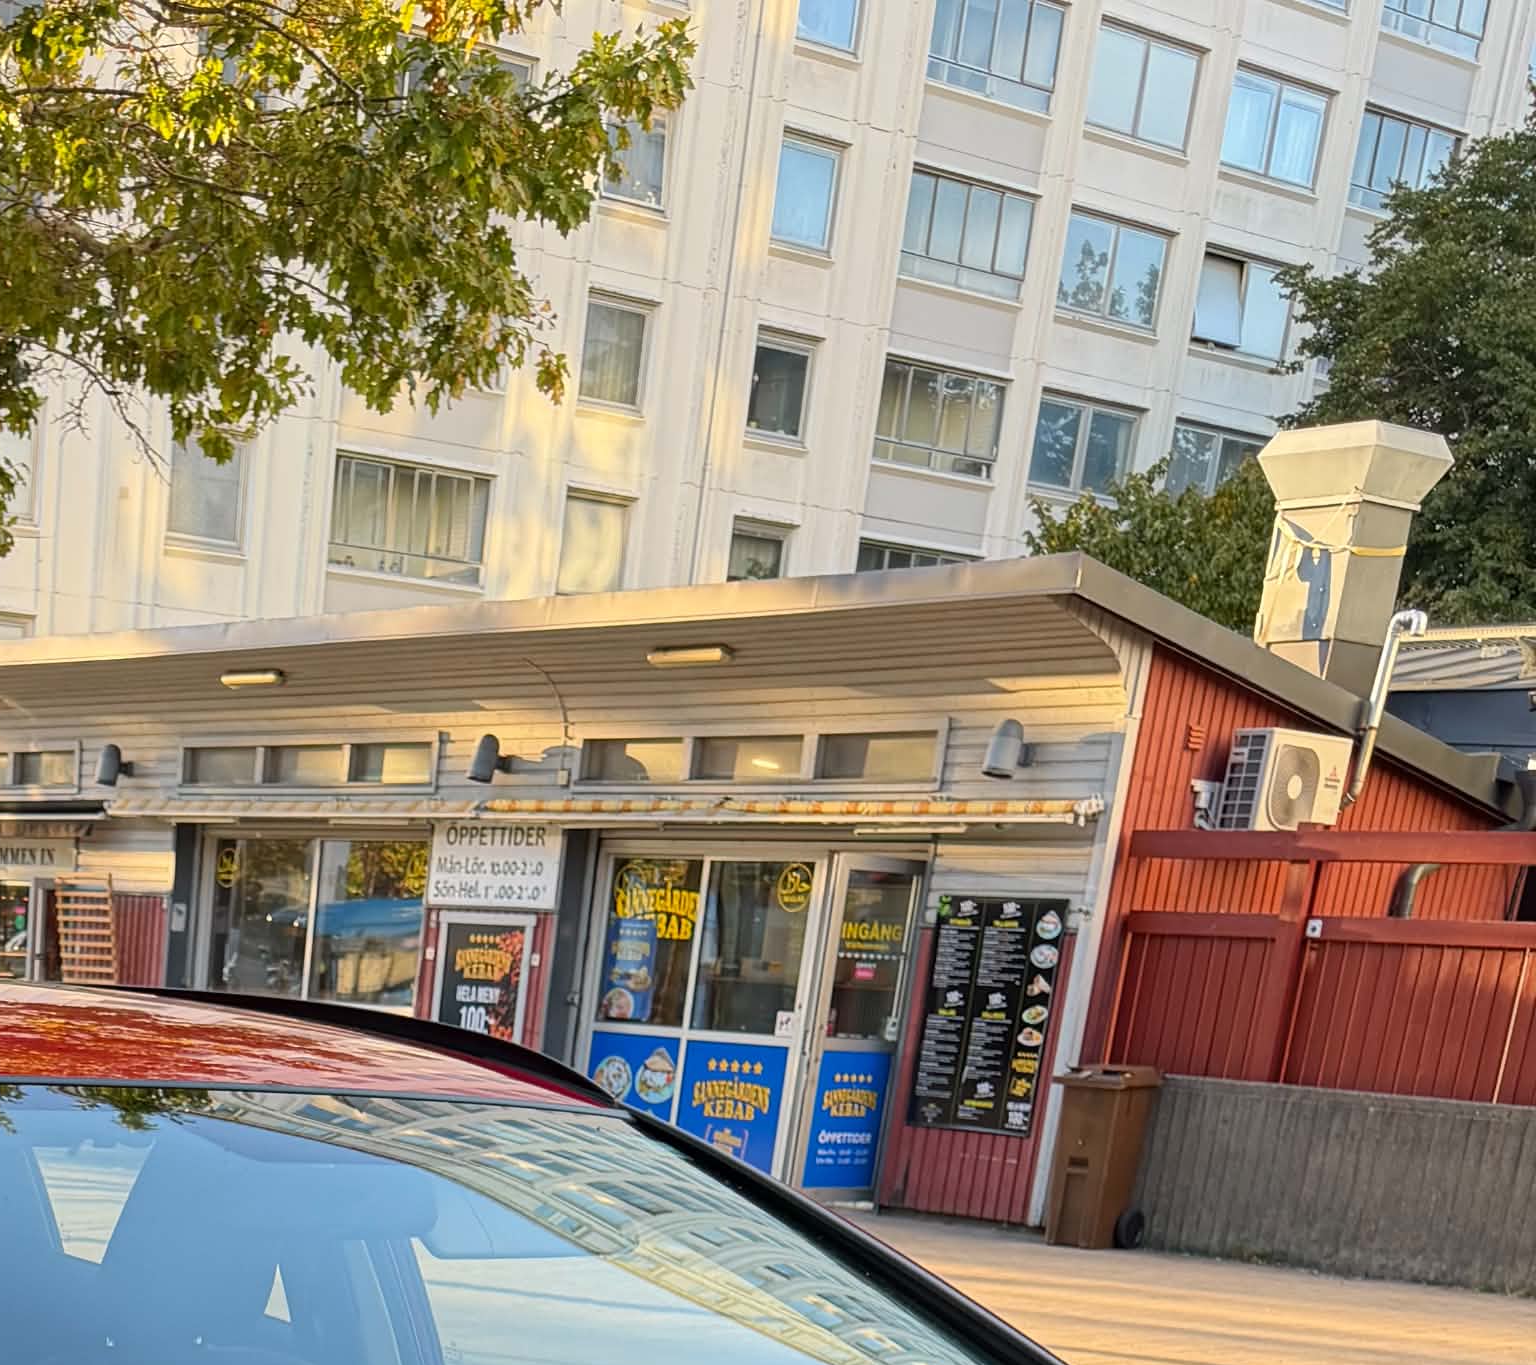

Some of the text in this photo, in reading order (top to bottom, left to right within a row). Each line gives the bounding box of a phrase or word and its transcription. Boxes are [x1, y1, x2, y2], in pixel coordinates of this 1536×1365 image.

[446, 822, 546, 847] ÖPPETTIDER
[40, 847, 56, 866] IN
[841, 920, 904, 941] INGÅNG
[692, 1076, 770, 1114] SANNEGÅRDENS
[703, 1099, 755, 1121] KEBAB
